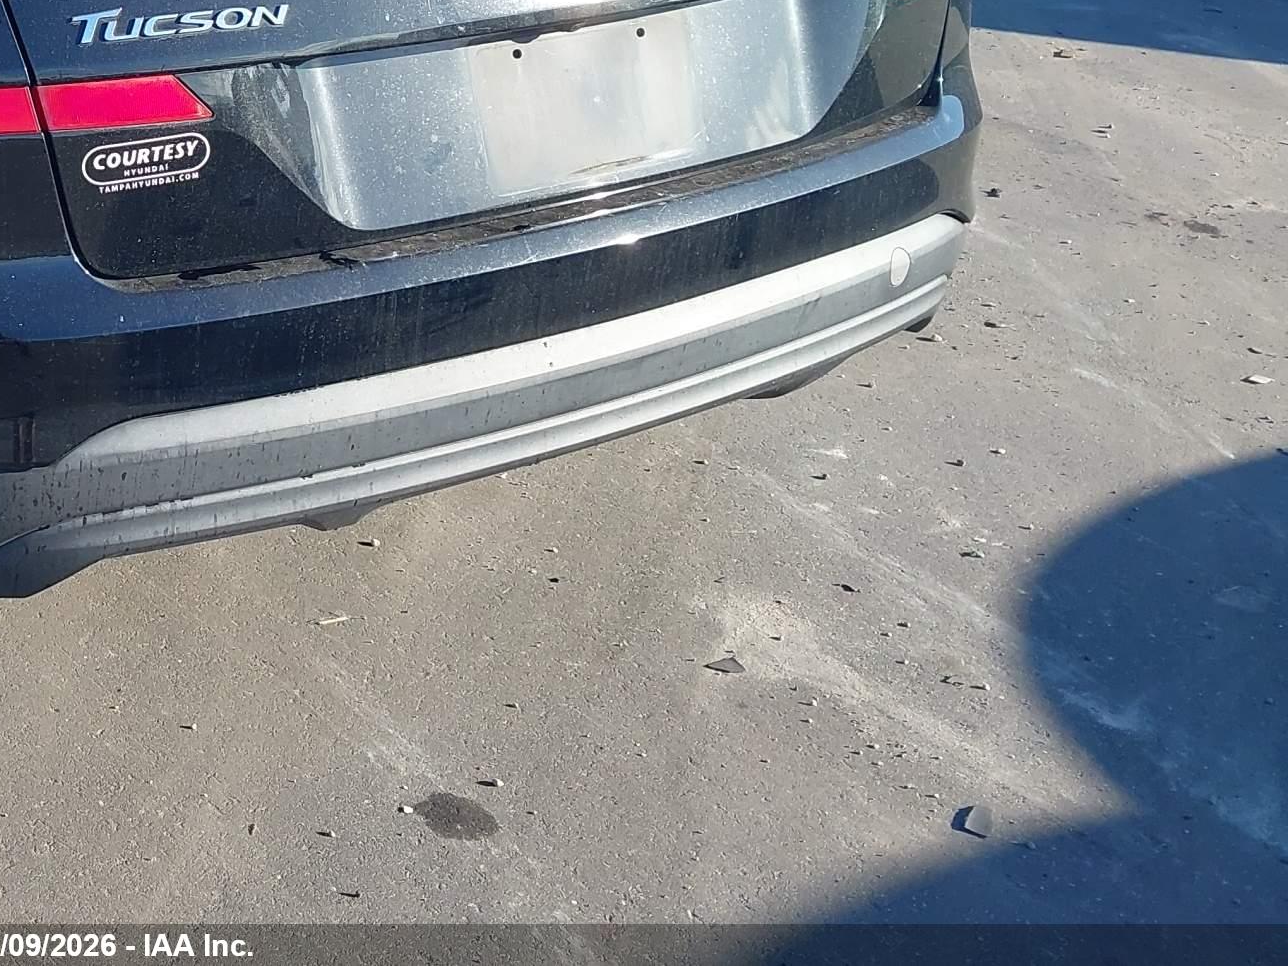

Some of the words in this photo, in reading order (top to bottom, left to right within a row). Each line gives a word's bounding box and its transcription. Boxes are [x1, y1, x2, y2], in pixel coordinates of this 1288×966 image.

[93, 140, 199, 170] COURTESY
[123, 163, 169, 177] HYUNDAI
[98, 171, 200, 194] TAMPAHYUNDAI.COM
